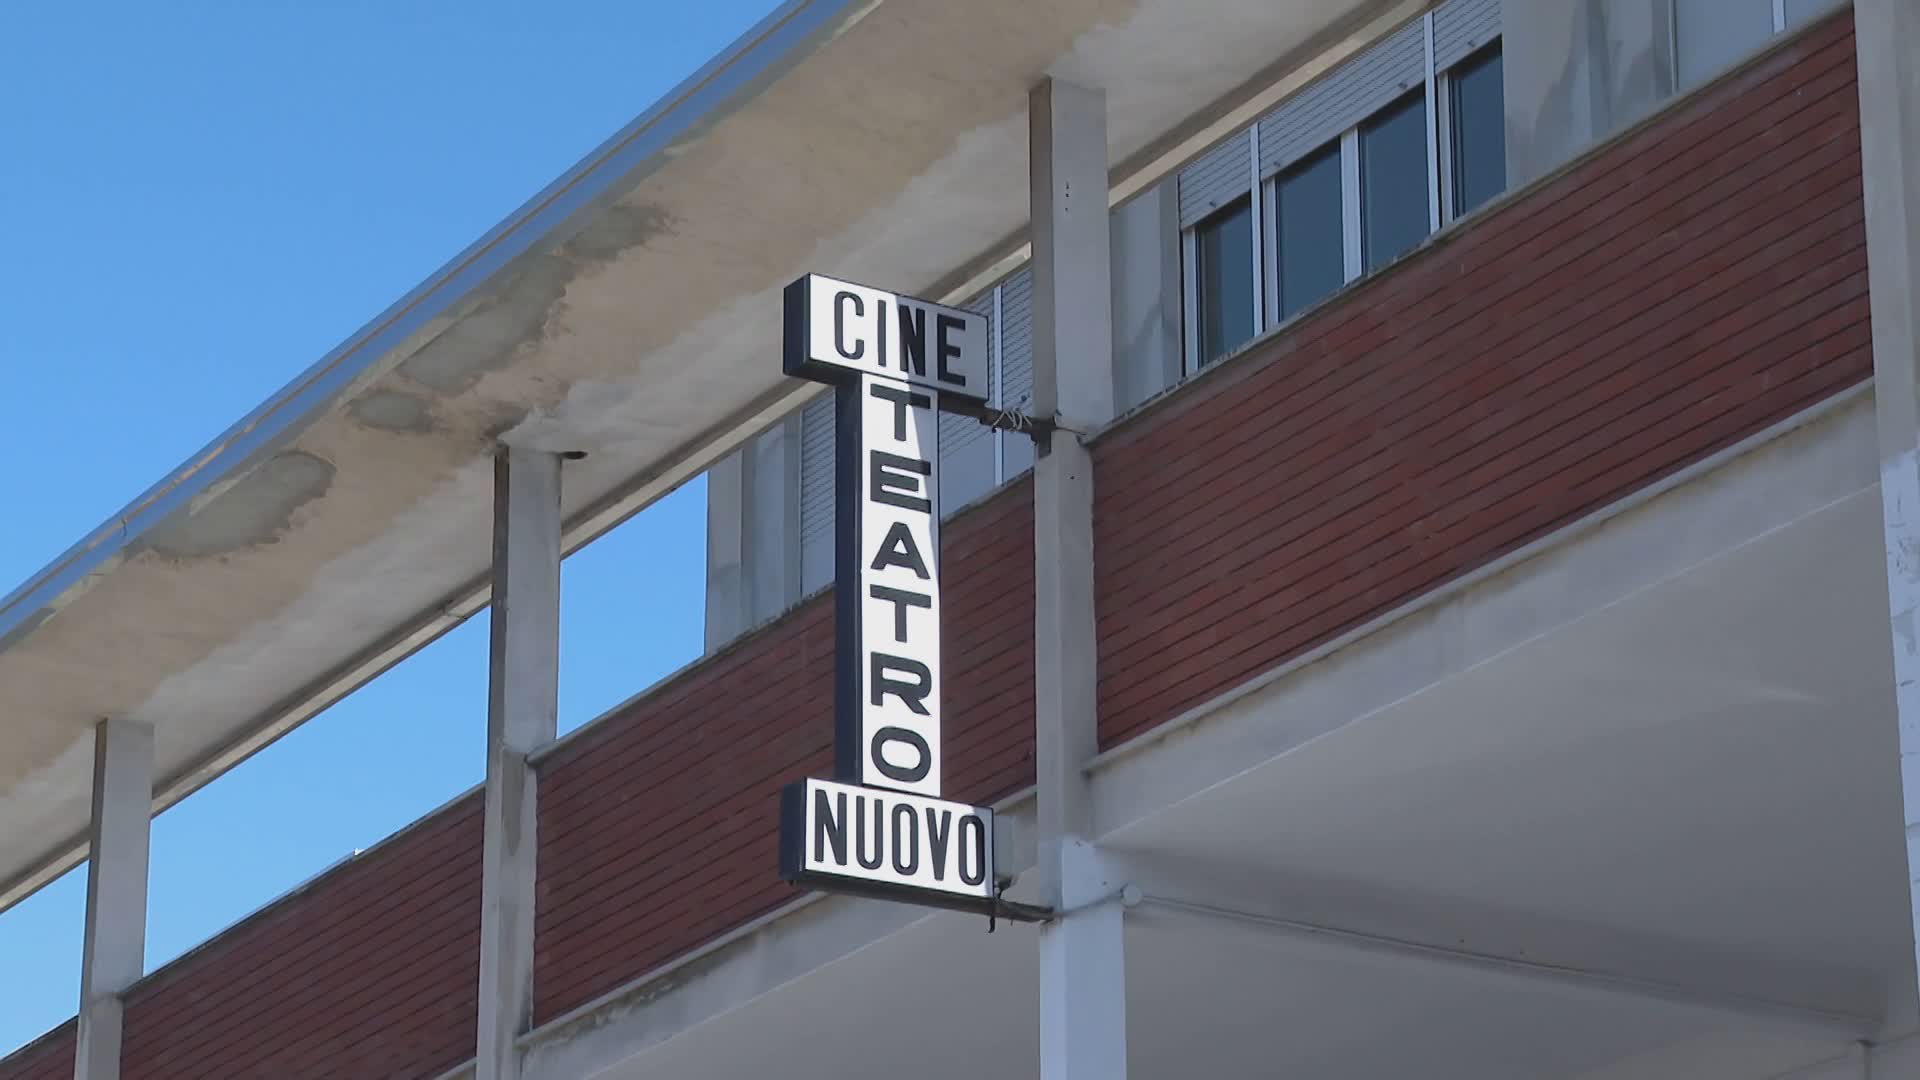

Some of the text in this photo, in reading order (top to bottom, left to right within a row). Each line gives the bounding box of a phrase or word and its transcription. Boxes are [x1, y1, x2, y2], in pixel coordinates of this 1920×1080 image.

[833, 290, 967, 387] CINE
[869, 382, 933, 783] TEATRO
[813, 788, 986, 886] NUOVO
